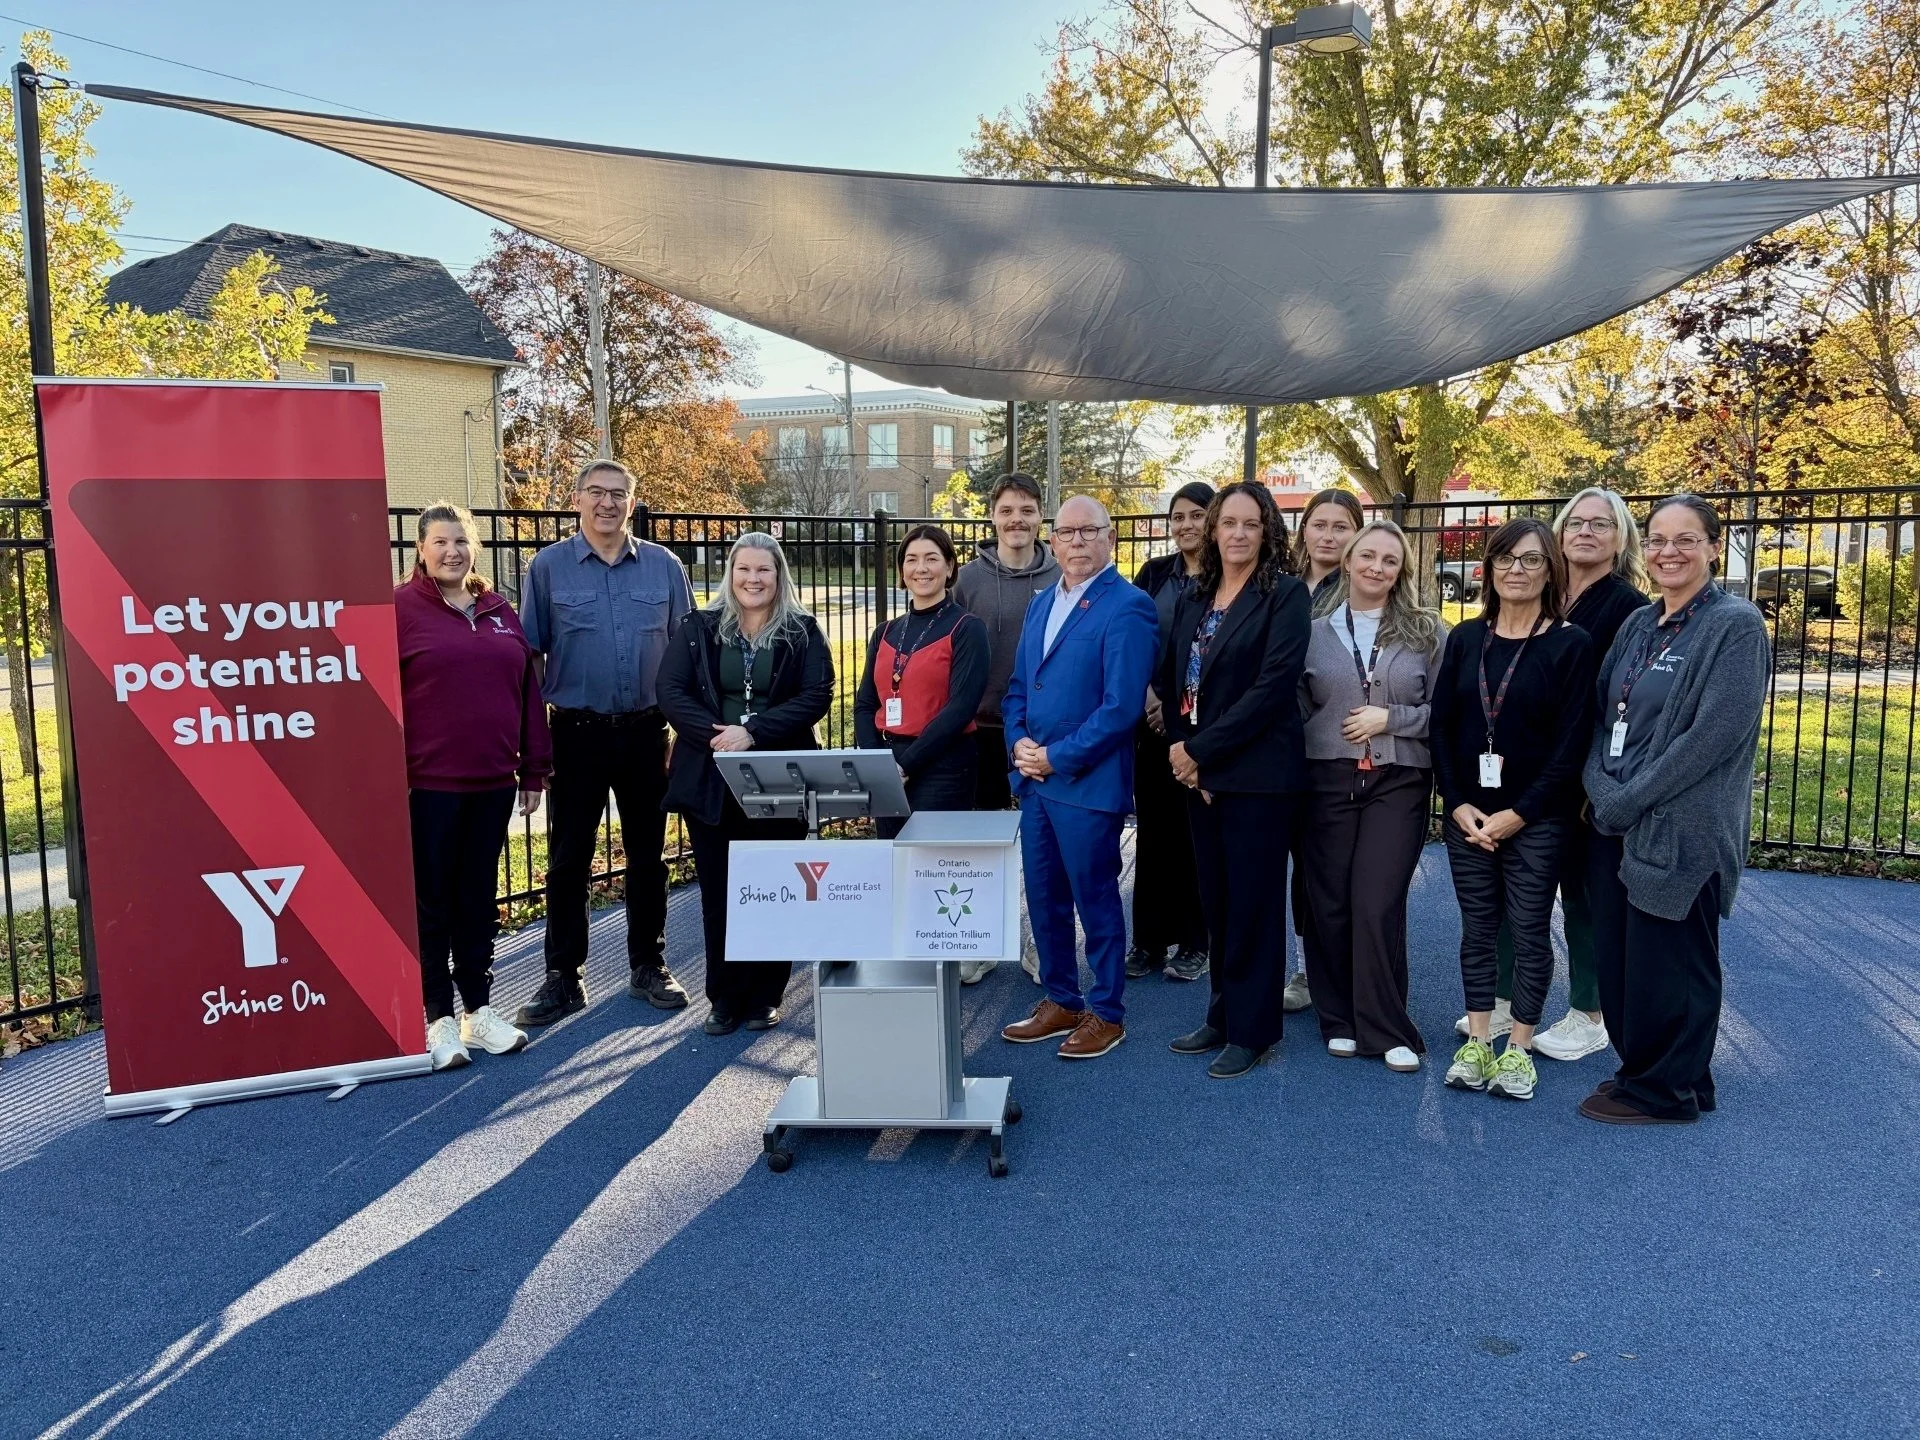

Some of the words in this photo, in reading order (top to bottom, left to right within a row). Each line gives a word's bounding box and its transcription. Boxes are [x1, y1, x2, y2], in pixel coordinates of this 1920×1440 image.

[121, 595, 209, 635] Let
[219, 599, 344, 642] your
[113, 645, 362, 702] potential
[172, 704, 316, 746] shine
[937, 858, 971, 867] Ontario
[914, 869, 946, 878] Trillium
[947, 869, 994, 878] Foundation
[827, 882, 861, 892] Central
[862, 882, 881, 892] East
[739, 884, 777, 905] Shine
[780, 885, 797, 903] On
[827, 892, 863, 901] Ontario
[915, 929, 958, 939] Fondation
[959, 929, 991, 939] Trillium
[928, 941, 940, 950] de
[941, 941, 978, 950] l'Ontario
[201, 985, 284, 1025] Shine
[291, 979, 327, 1013] On
